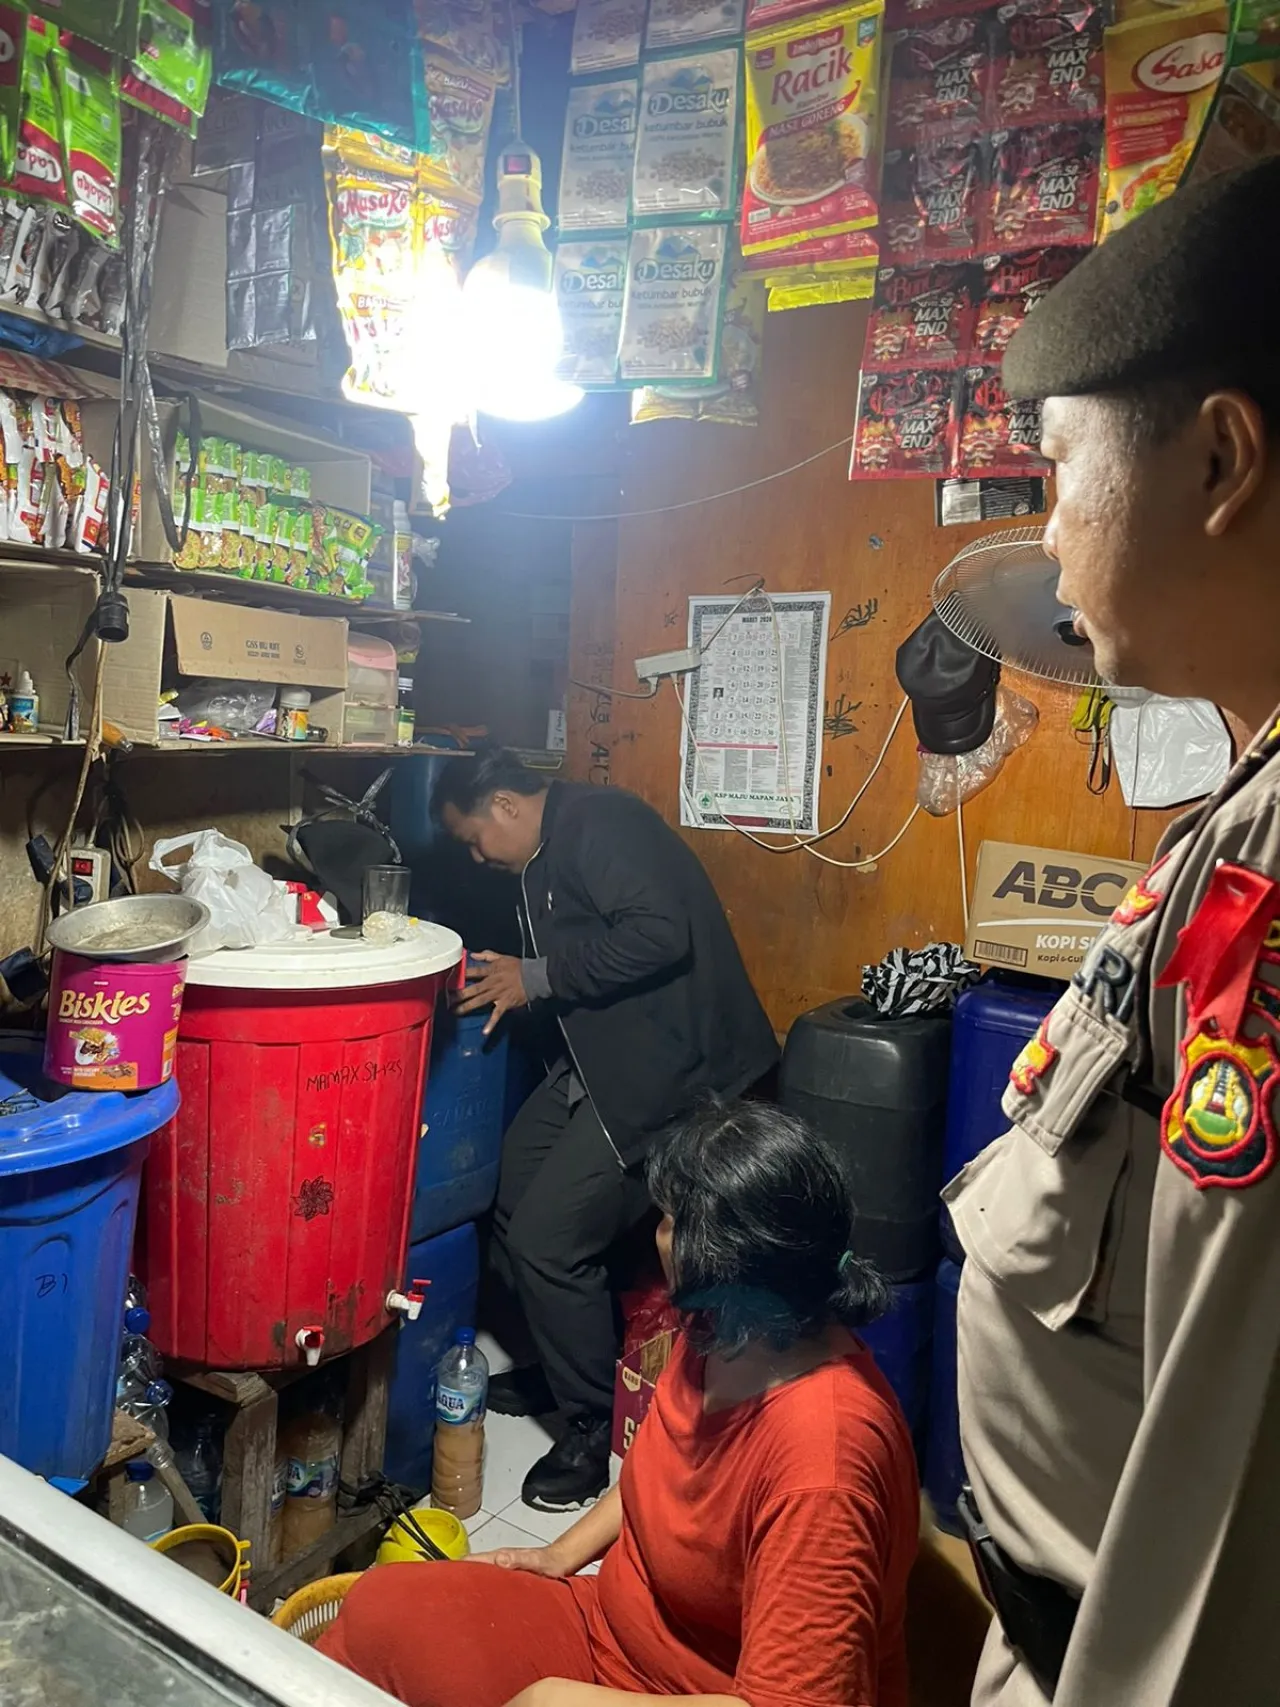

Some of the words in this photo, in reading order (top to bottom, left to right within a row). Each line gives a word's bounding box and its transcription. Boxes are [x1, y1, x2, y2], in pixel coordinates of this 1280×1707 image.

[1048, 49, 1089, 68] MAX
[1151, 45, 1225, 85] Sasa
[771, 47, 852, 105] Racik
[935, 68, 971, 88] MAX
[1049, 65, 1086, 85] END
[651, 83, 727, 114] Desaku
[935, 84, 969, 103] END
[576, 108, 635, 137] Desa
[769, 121, 798, 138] NASI
[801, 103, 844, 127] GORENG
[17, 149, 57, 179] Lada
[1038, 176, 1078, 194] MAX
[338, 188, 408, 219] Masako
[928, 191, 962, 210] MAX
[1039, 193, 1075, 211] END
[928, 207, 960, 226] END
[637, 254, 716, 284] Desaku
[632, 288, 679, 300] ketumbar
[681, 287, 712, 298] bubuk
[914, 307, 951, 322] MAX
[915, 322, 948, 337] END
[901, 419, 936, 435] MAX
[901, 435, 933, 449] END
[992, 860, 1128, 916] ABC
[1036, 934, 1076, 950] KOPI
[58, 989, 150, 1025] Biskies
